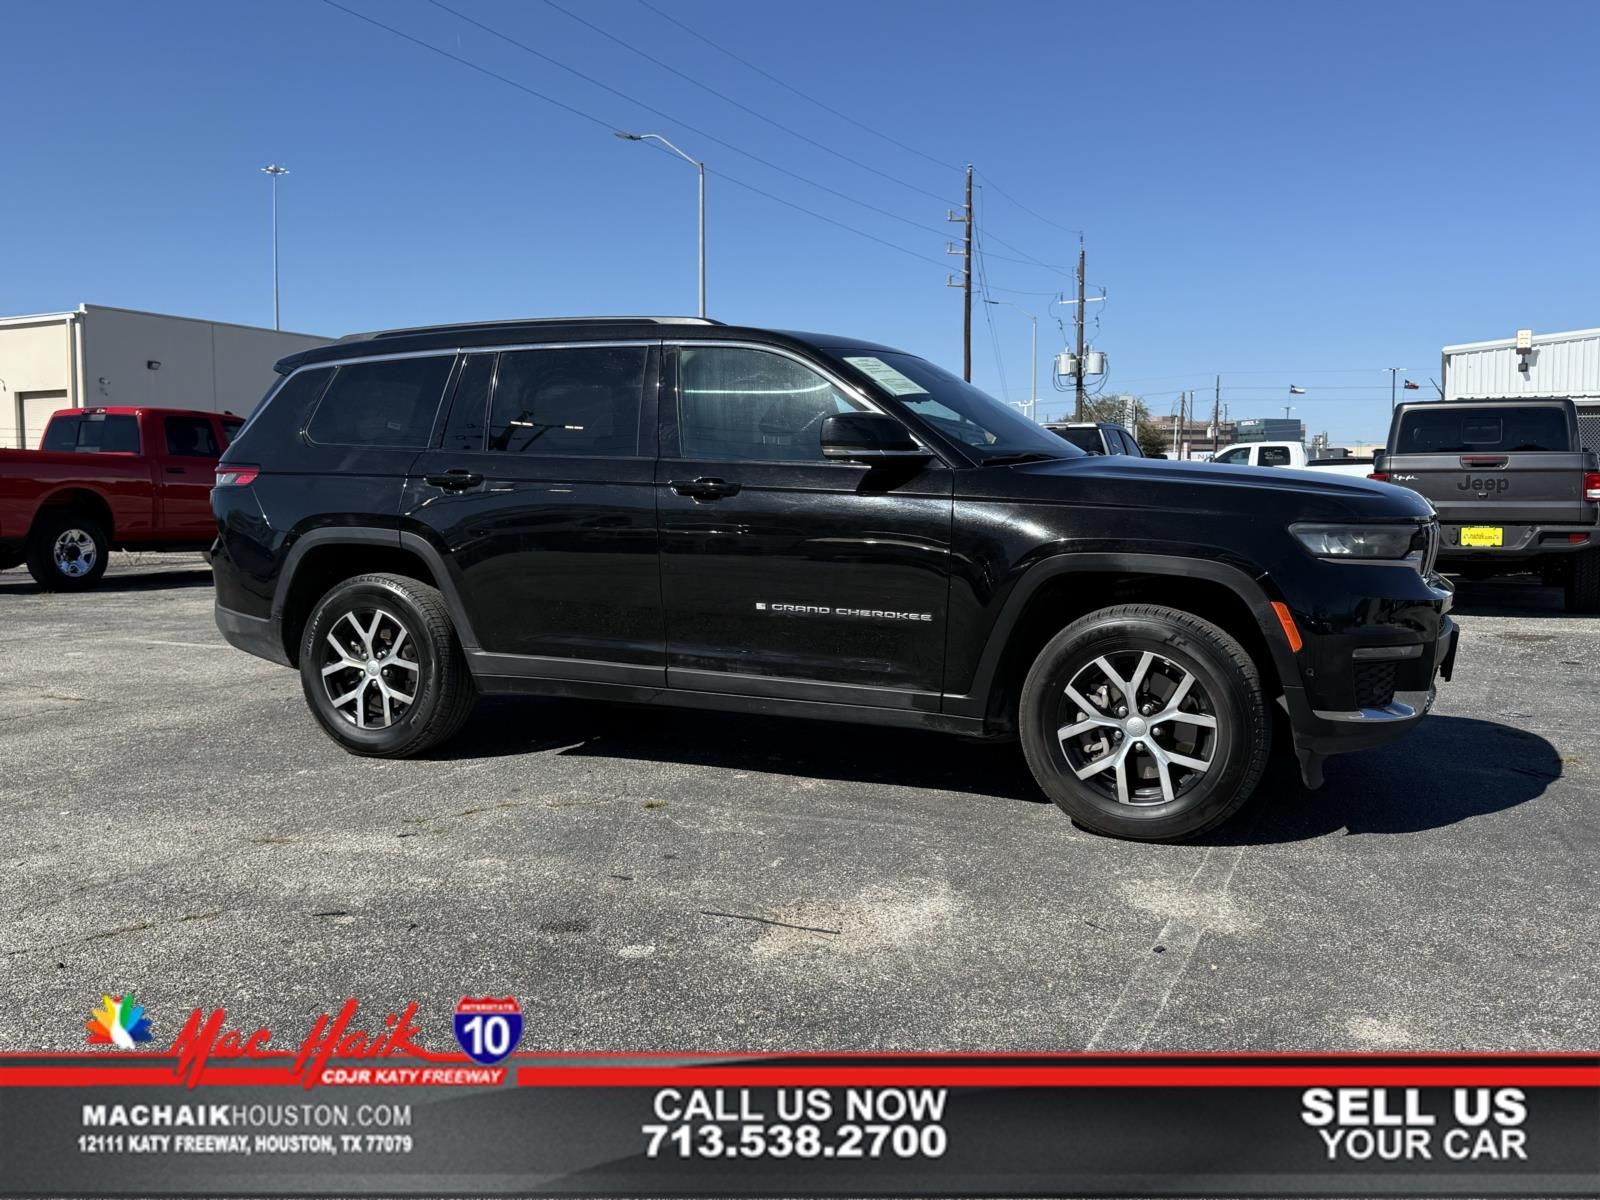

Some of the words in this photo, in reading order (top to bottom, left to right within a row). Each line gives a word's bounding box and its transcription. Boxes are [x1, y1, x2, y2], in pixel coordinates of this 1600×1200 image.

[1457, 475, 1510, 494] Jeep
[771, 603, 831, 614] GRAND
[835, 608, 933, 622] CHEROKEE
